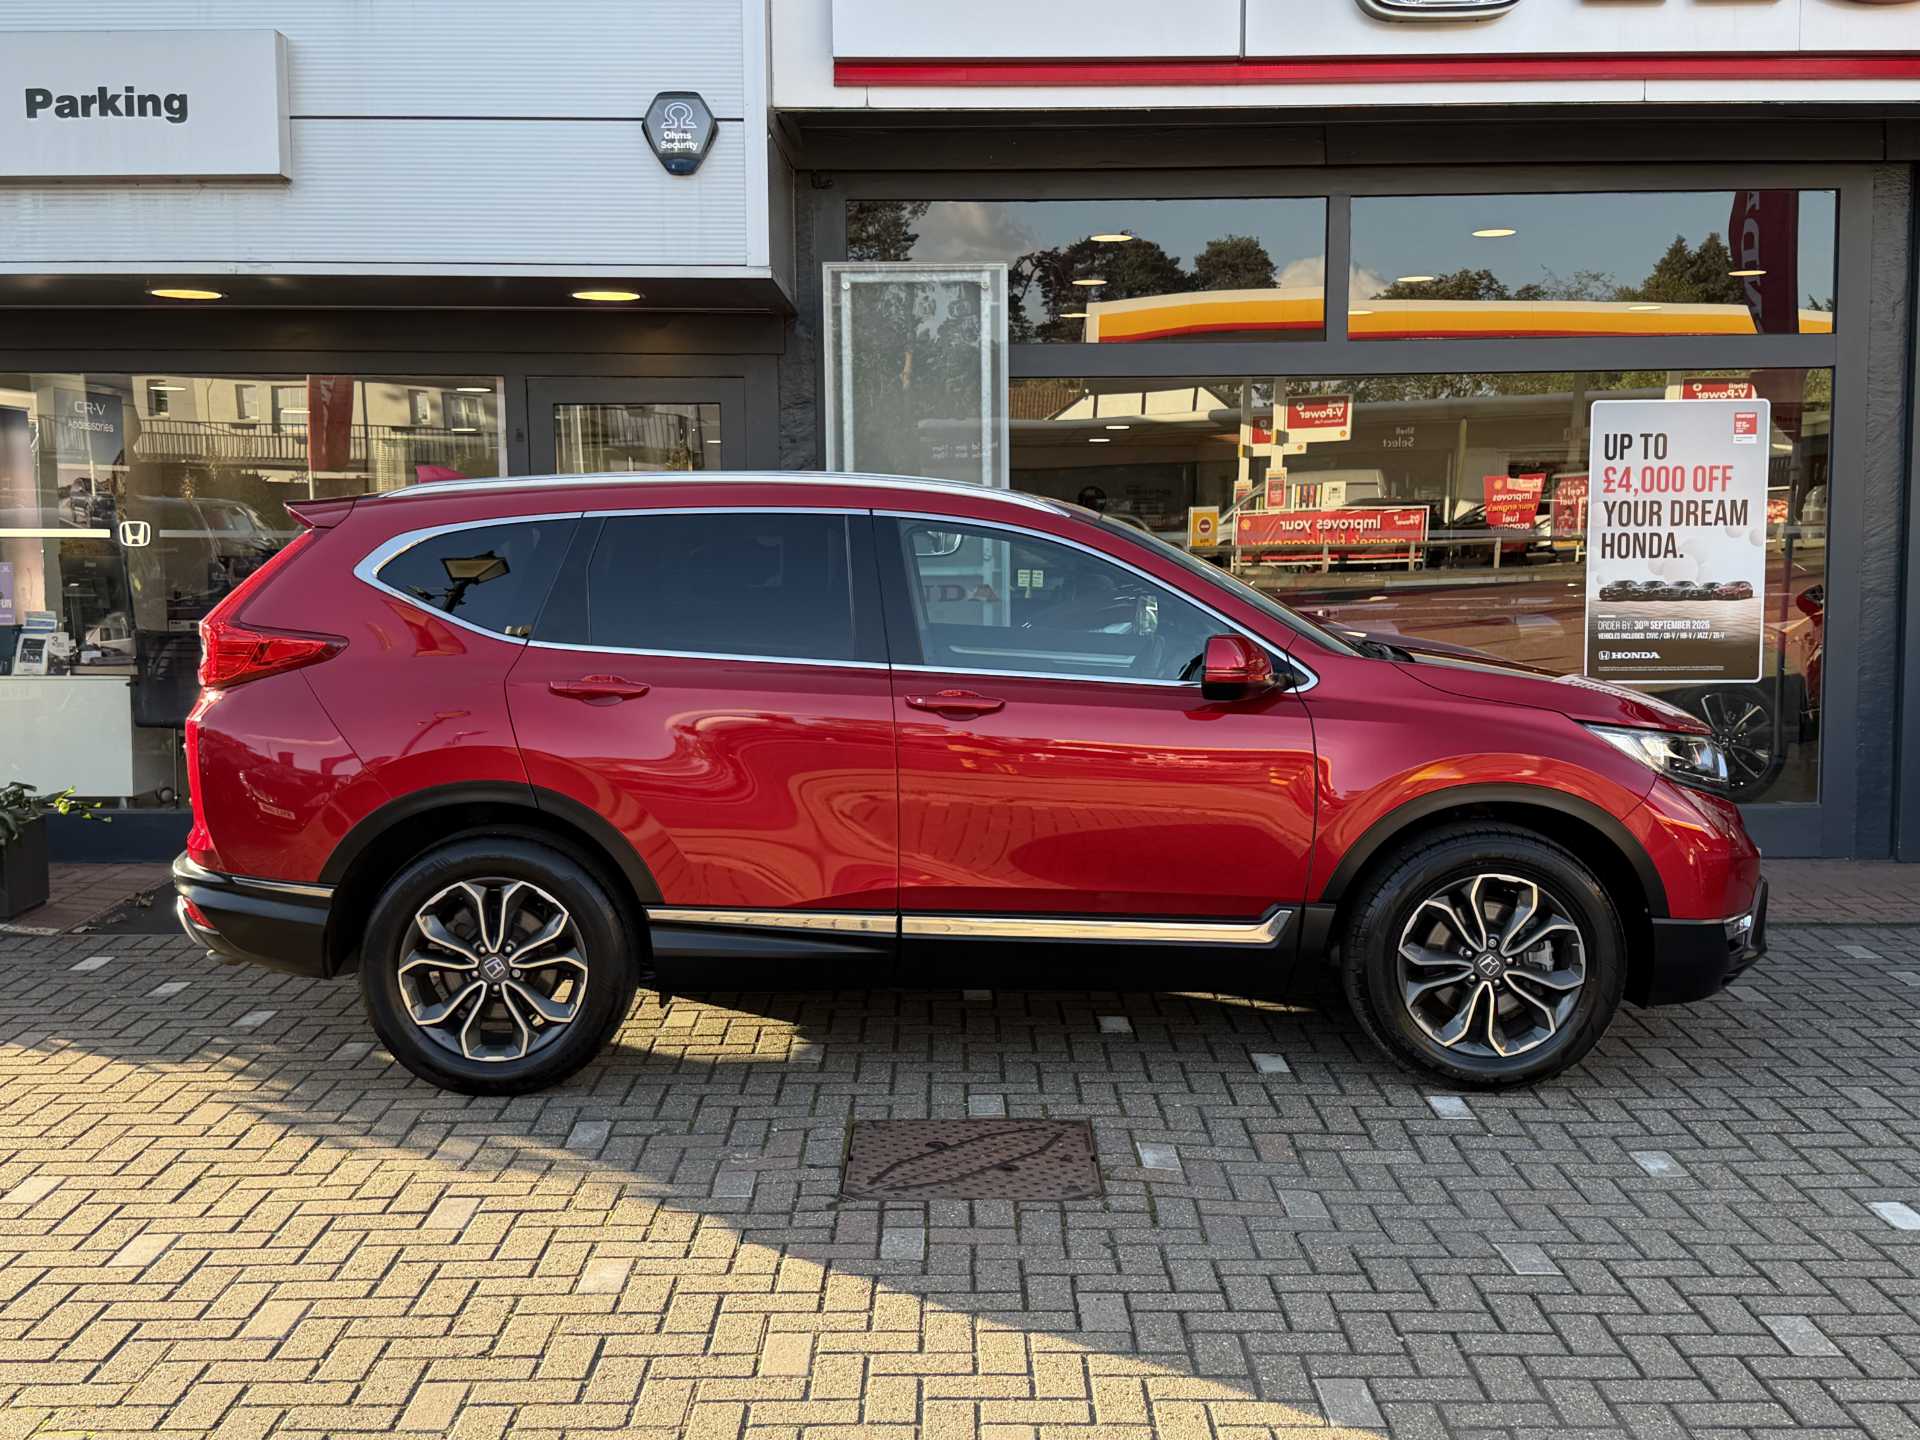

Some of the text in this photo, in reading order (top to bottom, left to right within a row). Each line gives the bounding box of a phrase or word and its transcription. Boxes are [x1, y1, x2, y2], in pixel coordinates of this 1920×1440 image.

[25, 86, 188, 123] Parking
[660, 141, 698, 151] Security
[663, 131, 692, 140] Ohms
[1604, 432, 1668, 461] UP TO
[1602, 464, 1734, 497] £4,000 OFF
[1603, 499, 1748, 527] YOUR DREAM
[1601, 532, 1685, 559] HONDA.
[1598, 620, 1620, 630] ORDER
[1650, 620, 1691, 629] SEPTEMBER
[1611, 651, 1661, 659] HONDA
